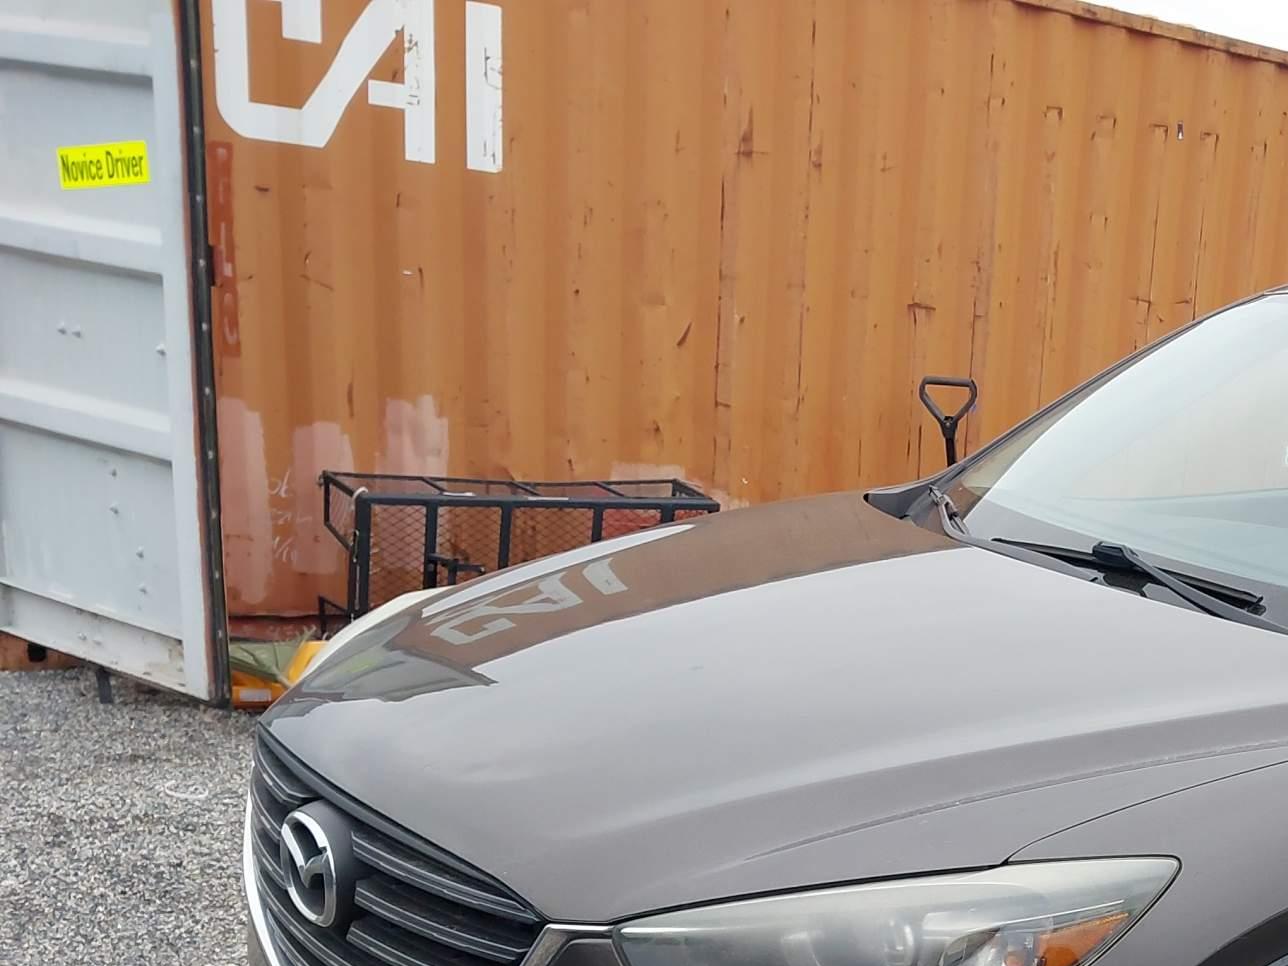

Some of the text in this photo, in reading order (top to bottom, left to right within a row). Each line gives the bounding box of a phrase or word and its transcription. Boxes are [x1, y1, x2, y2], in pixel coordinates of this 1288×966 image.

[212, 0, 502, 173] CAI
[60, 148, 144, 182] Novice Driver
